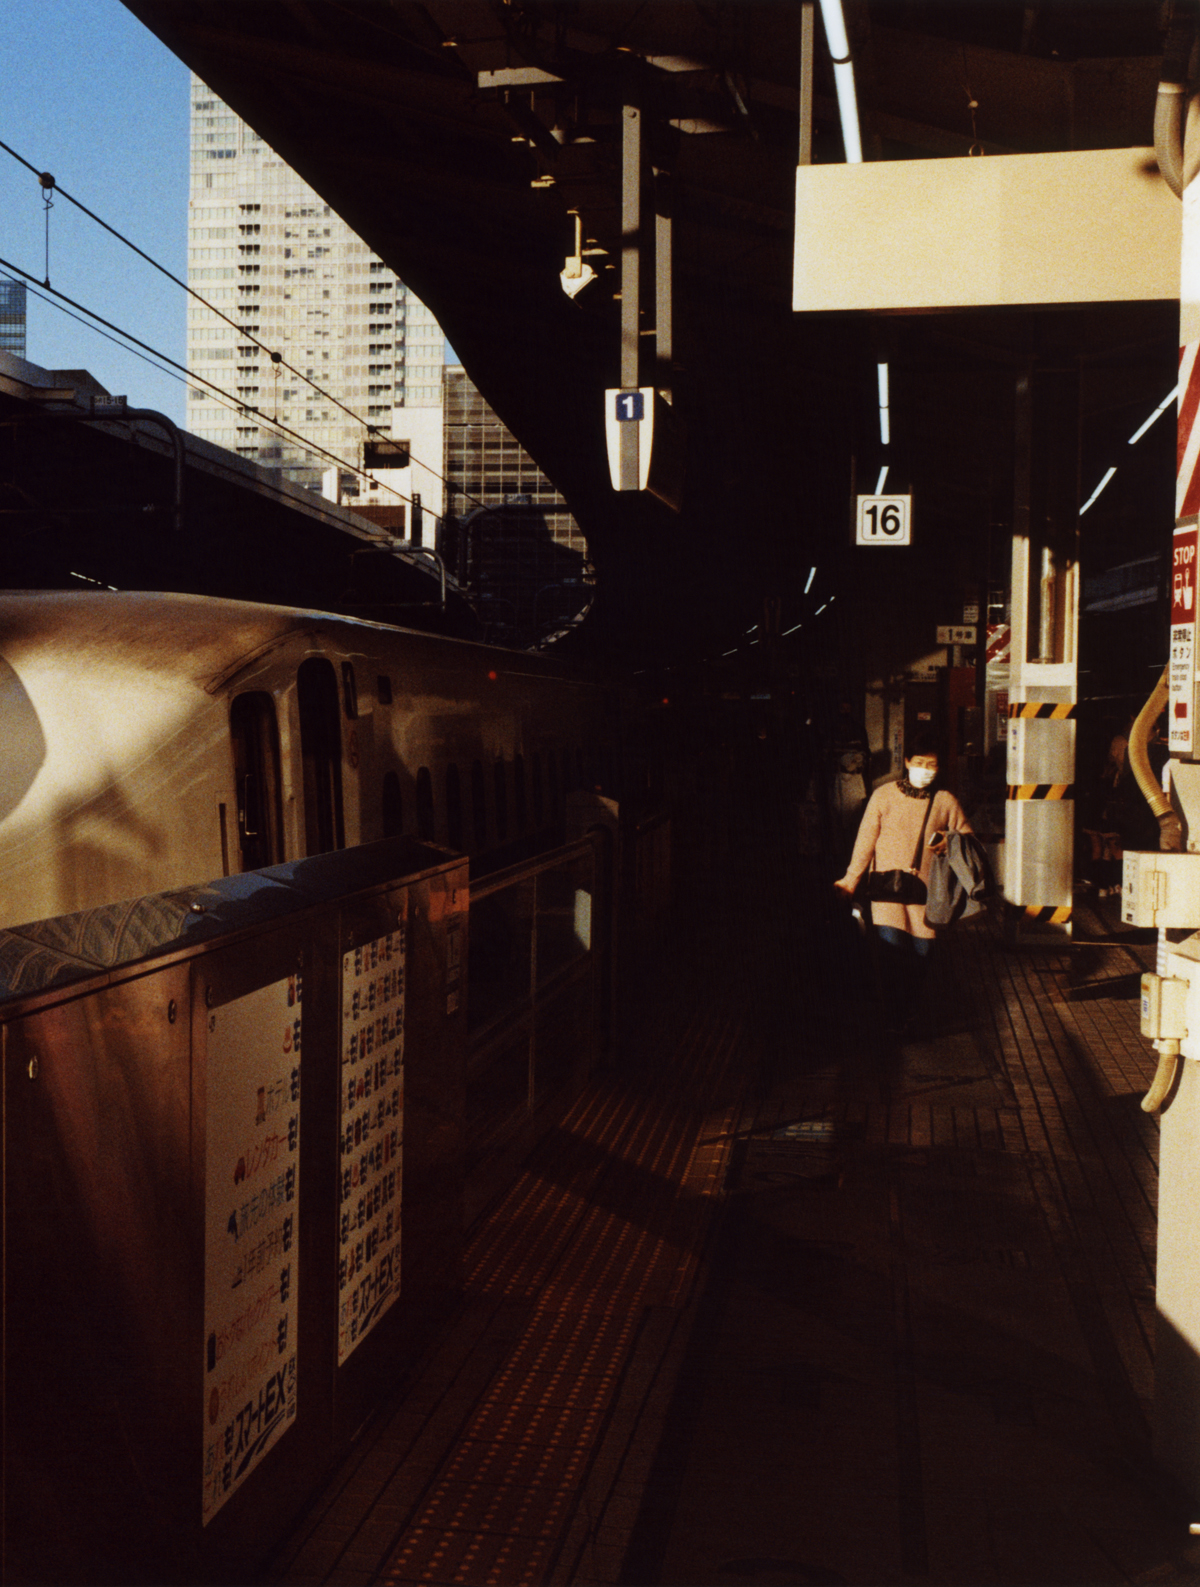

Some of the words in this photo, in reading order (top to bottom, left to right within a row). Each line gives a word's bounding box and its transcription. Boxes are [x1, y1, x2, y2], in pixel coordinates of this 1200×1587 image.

[622, 395, 634, 419] 1
[865, 504, 901, 536] 16
[1173, 545, 1196, 567] STOP
[234, 1360, 287, 1460] スマートEX
